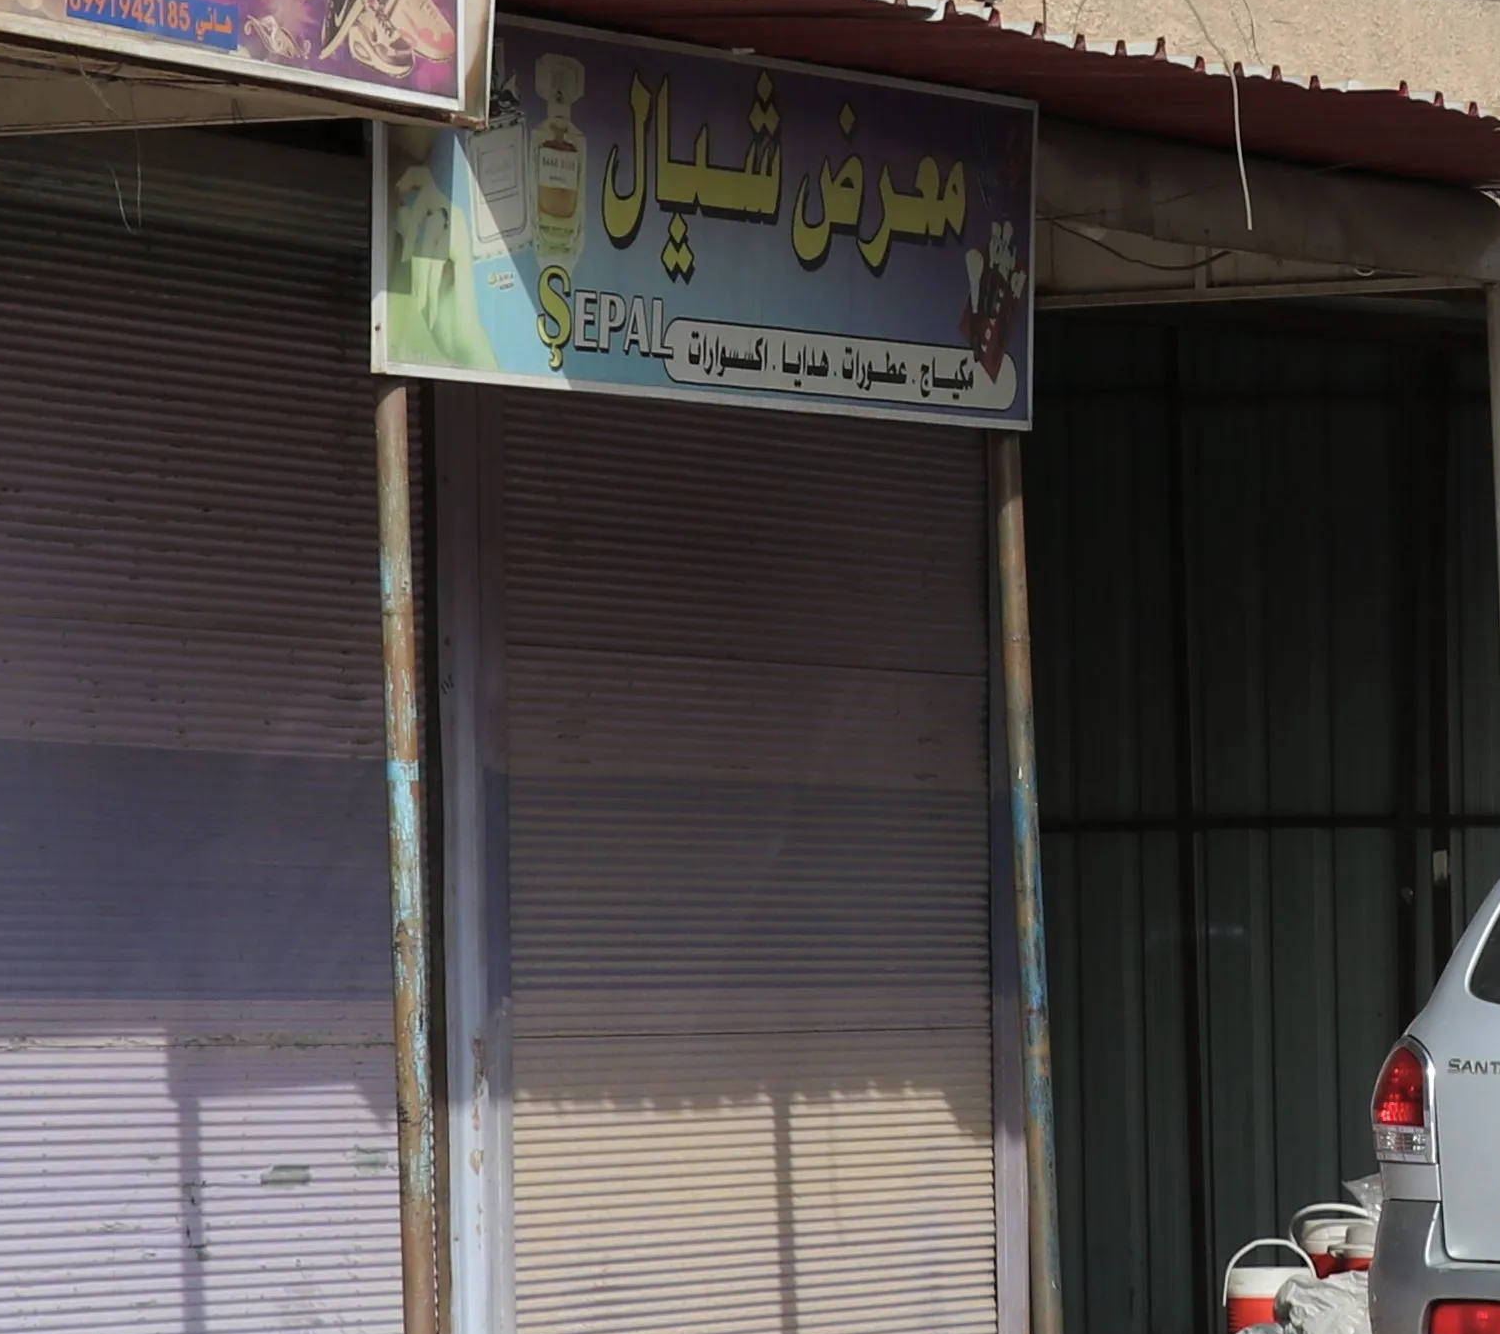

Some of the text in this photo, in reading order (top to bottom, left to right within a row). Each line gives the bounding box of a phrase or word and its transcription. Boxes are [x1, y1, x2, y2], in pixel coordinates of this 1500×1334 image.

[196, 7, 232, 40] هاني
[791, 101, 966, 273] معرض
[781, 340, 829, 387] هدايا
[842, 347, 907, 391] عطورات
[920, 357, 974, 398] مكياج
